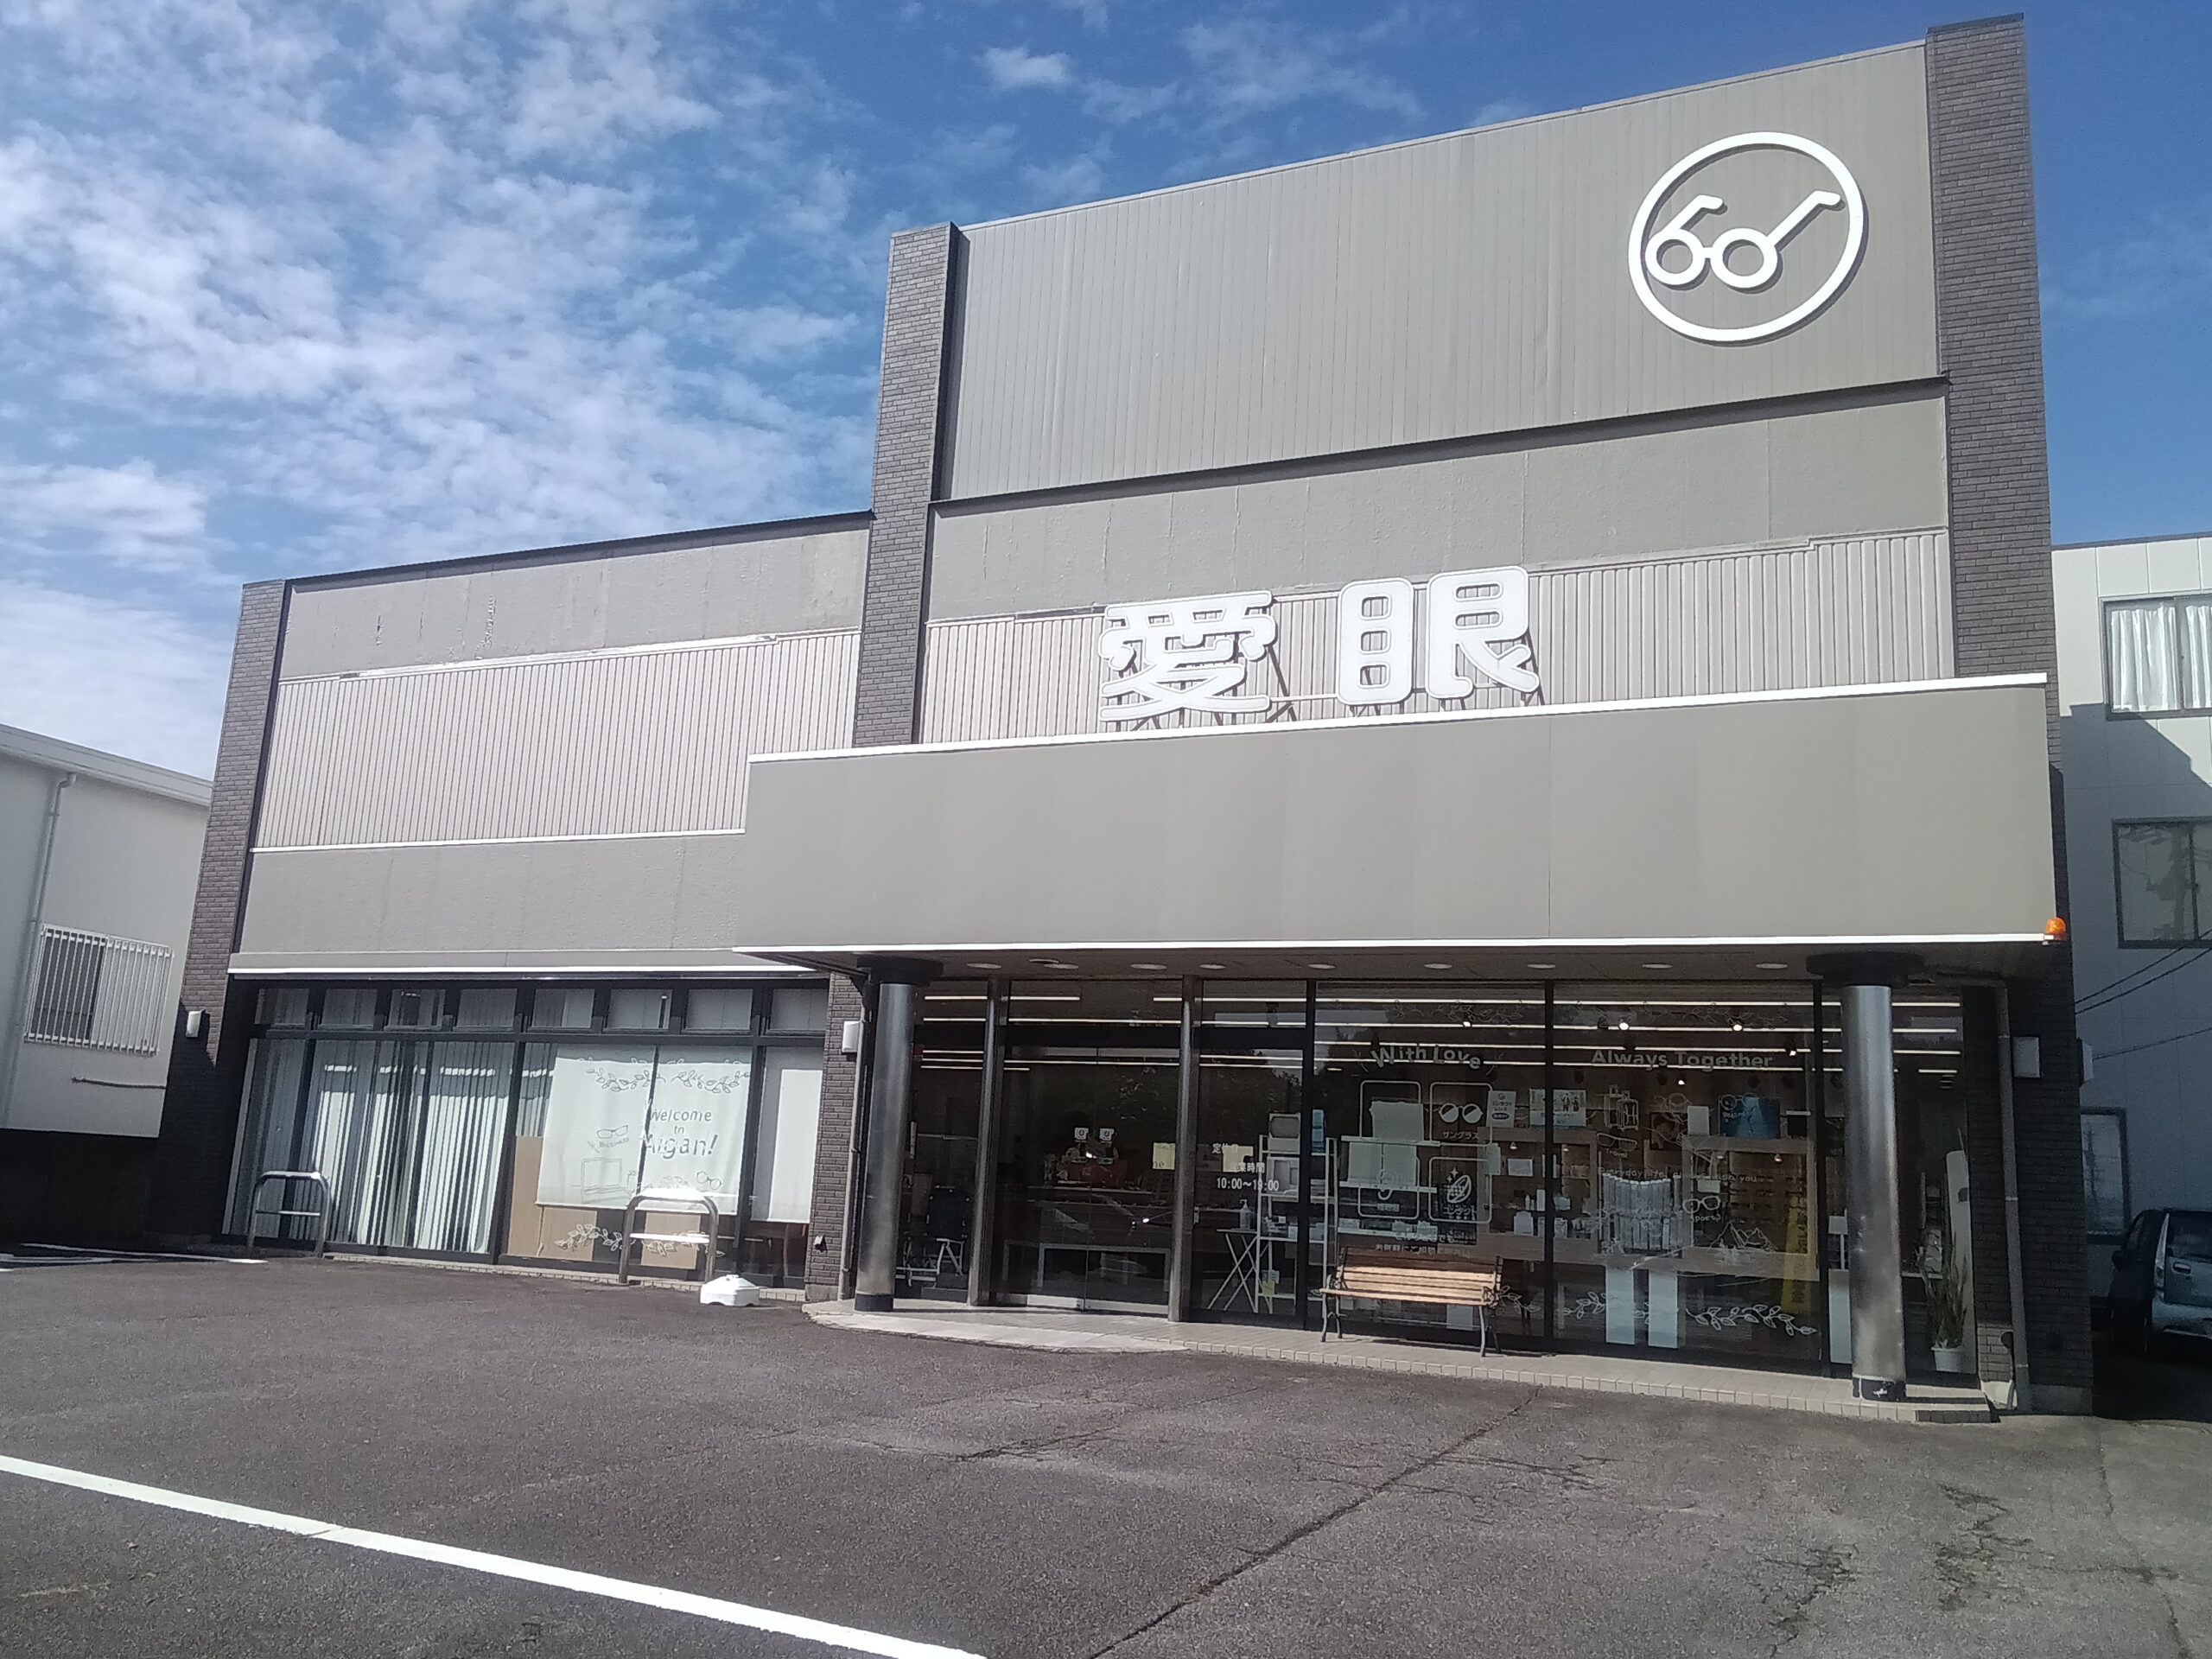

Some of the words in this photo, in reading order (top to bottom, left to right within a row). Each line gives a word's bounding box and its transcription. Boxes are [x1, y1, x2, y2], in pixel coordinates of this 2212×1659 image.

[1099, 565, 1540, 722] 愛眼
[1370, 1046, 1426, 1068] With
[1433, 1045, 1481, 1069] Love
[1591, 1050, 1668, 1071] Always
[1675, 1051, 1773, 1072] Together
[651, 1109, 712, 1122] Welcome
[674, 1125, 684, 1135] to
[1443, 1131, 1479, 1140] サングラス
[643, 1135, 718, 1159] Aigan!
[1443, 1205, 1478, 1217] コンタクト
